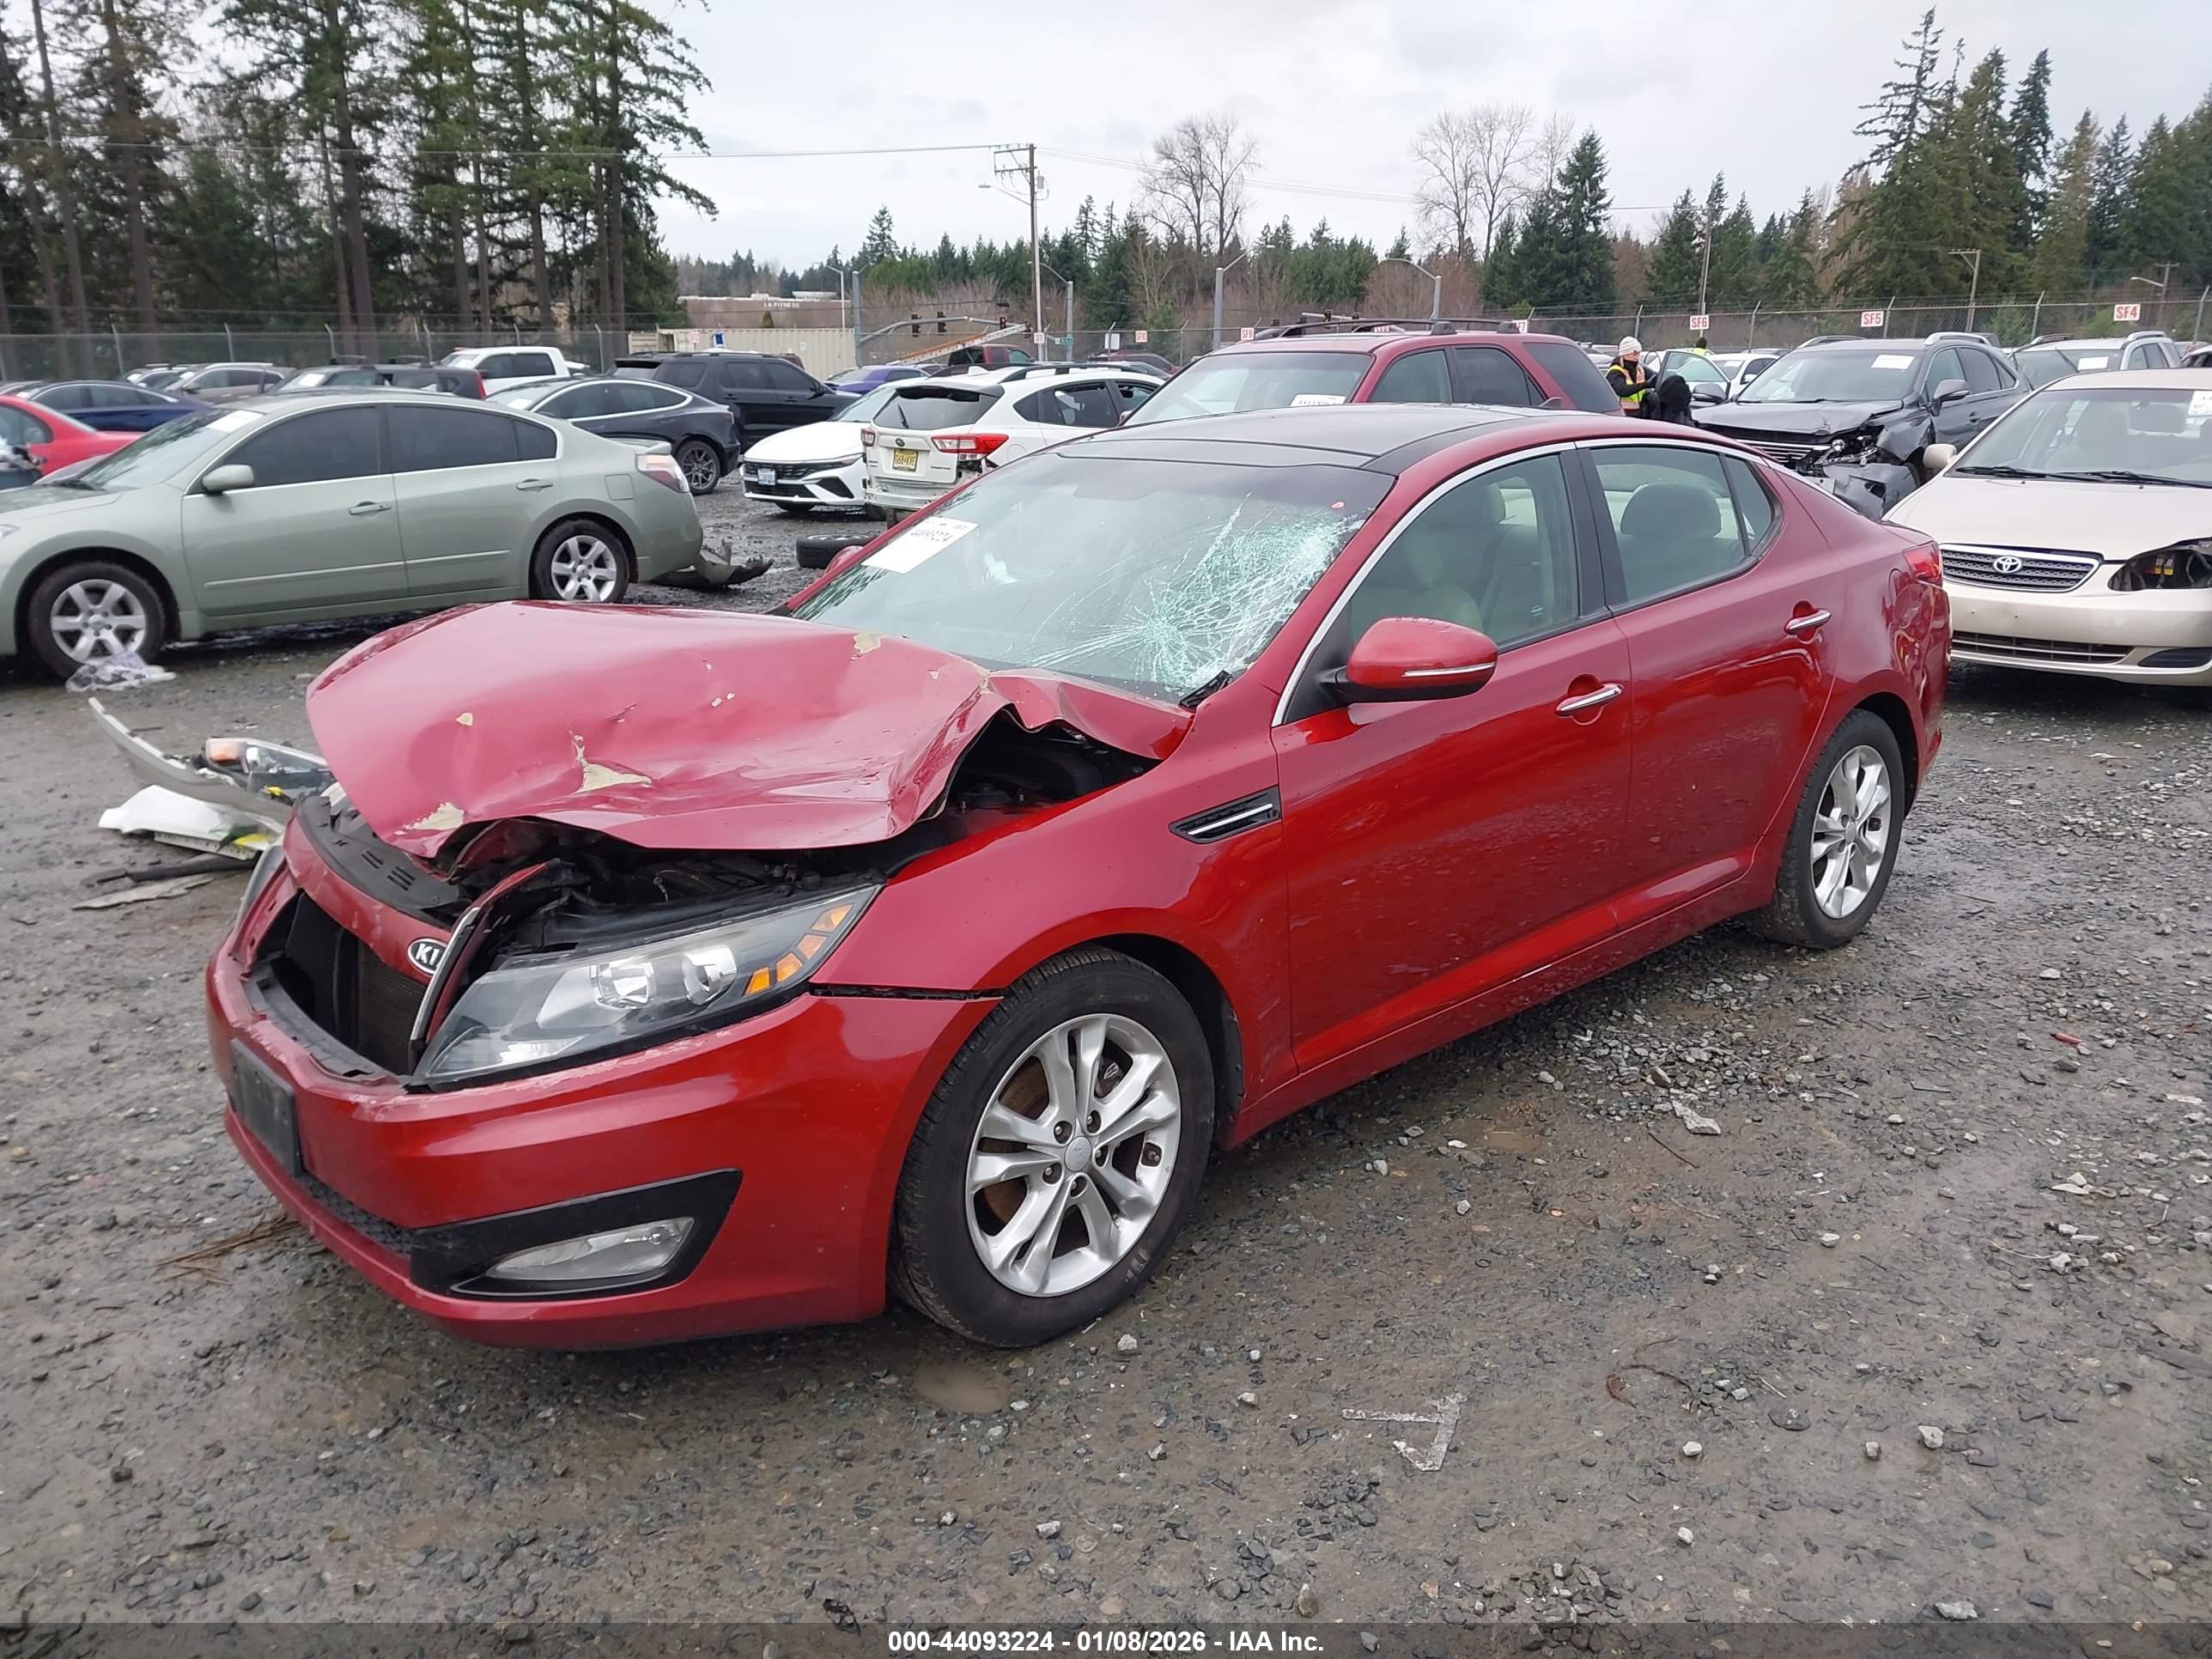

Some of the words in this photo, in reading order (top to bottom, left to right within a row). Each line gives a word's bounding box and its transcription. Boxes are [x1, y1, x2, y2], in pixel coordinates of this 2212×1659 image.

[2116, 306, 2137, 319] SF4
[1692, 317, 1707, 328] SF6
[1863, 313, 1881, 325] SF5
[1242, 329, 1253, 338] SF9
[416, 943, 441, 966] KI
